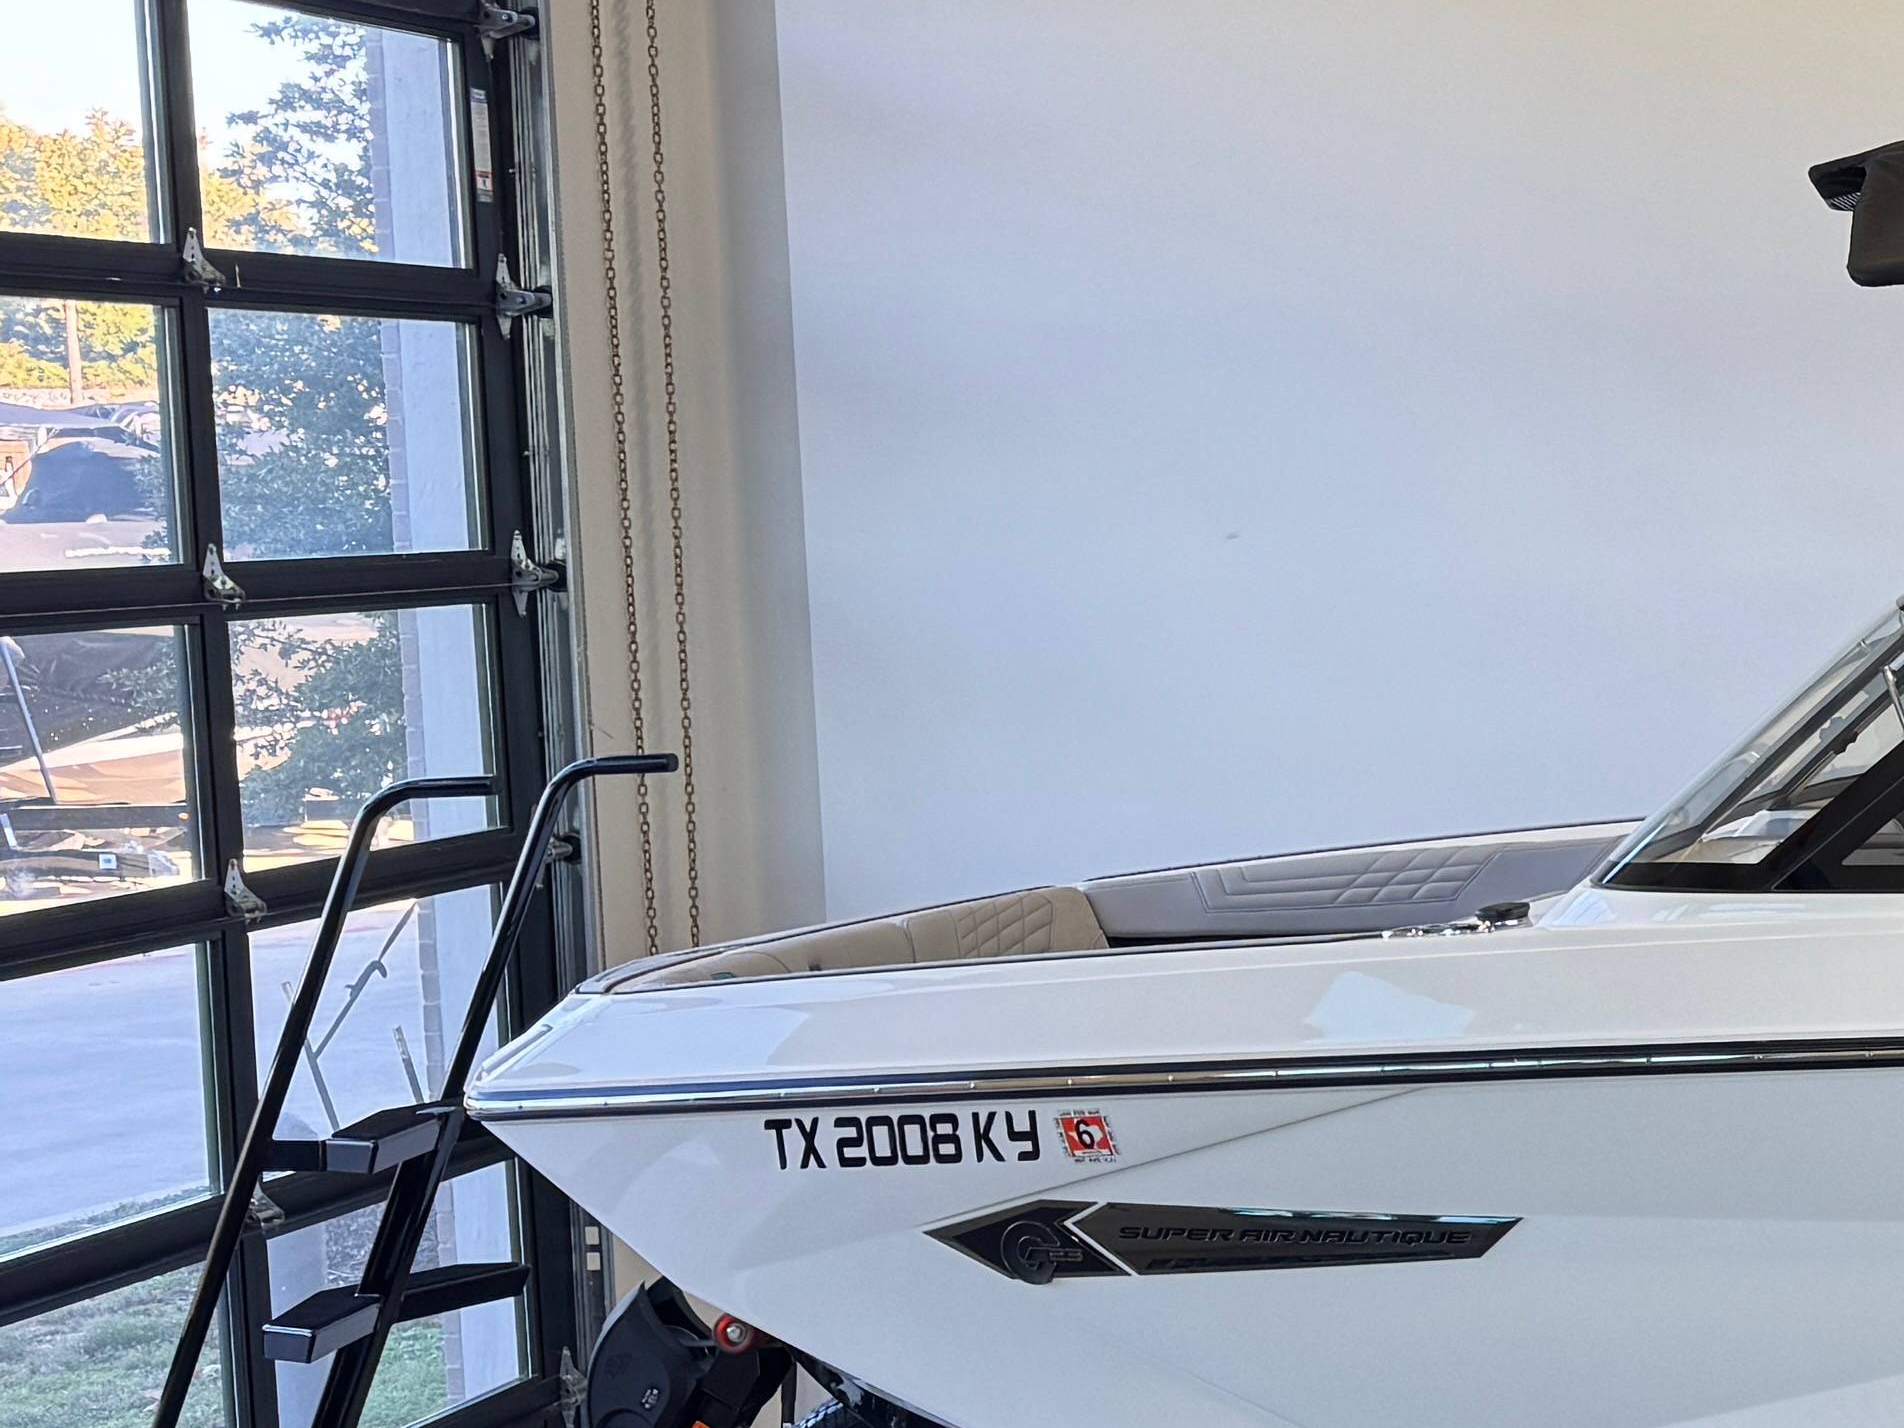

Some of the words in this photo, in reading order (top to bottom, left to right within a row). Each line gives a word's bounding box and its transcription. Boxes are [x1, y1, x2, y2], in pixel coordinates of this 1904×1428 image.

[763, 1116, 827, 1171] TX
[833, 1112, 963, 1169] 2008
[971, 1109, 1041, 1164] KY
[1074, 1118, 1095, 1150] 6
[1118, 1225, 1236, 1242] SUPER
[1239, 1227, 1297, 1243] AIR
[1299, 1228, 1472, 1246] NAUTIQUE
